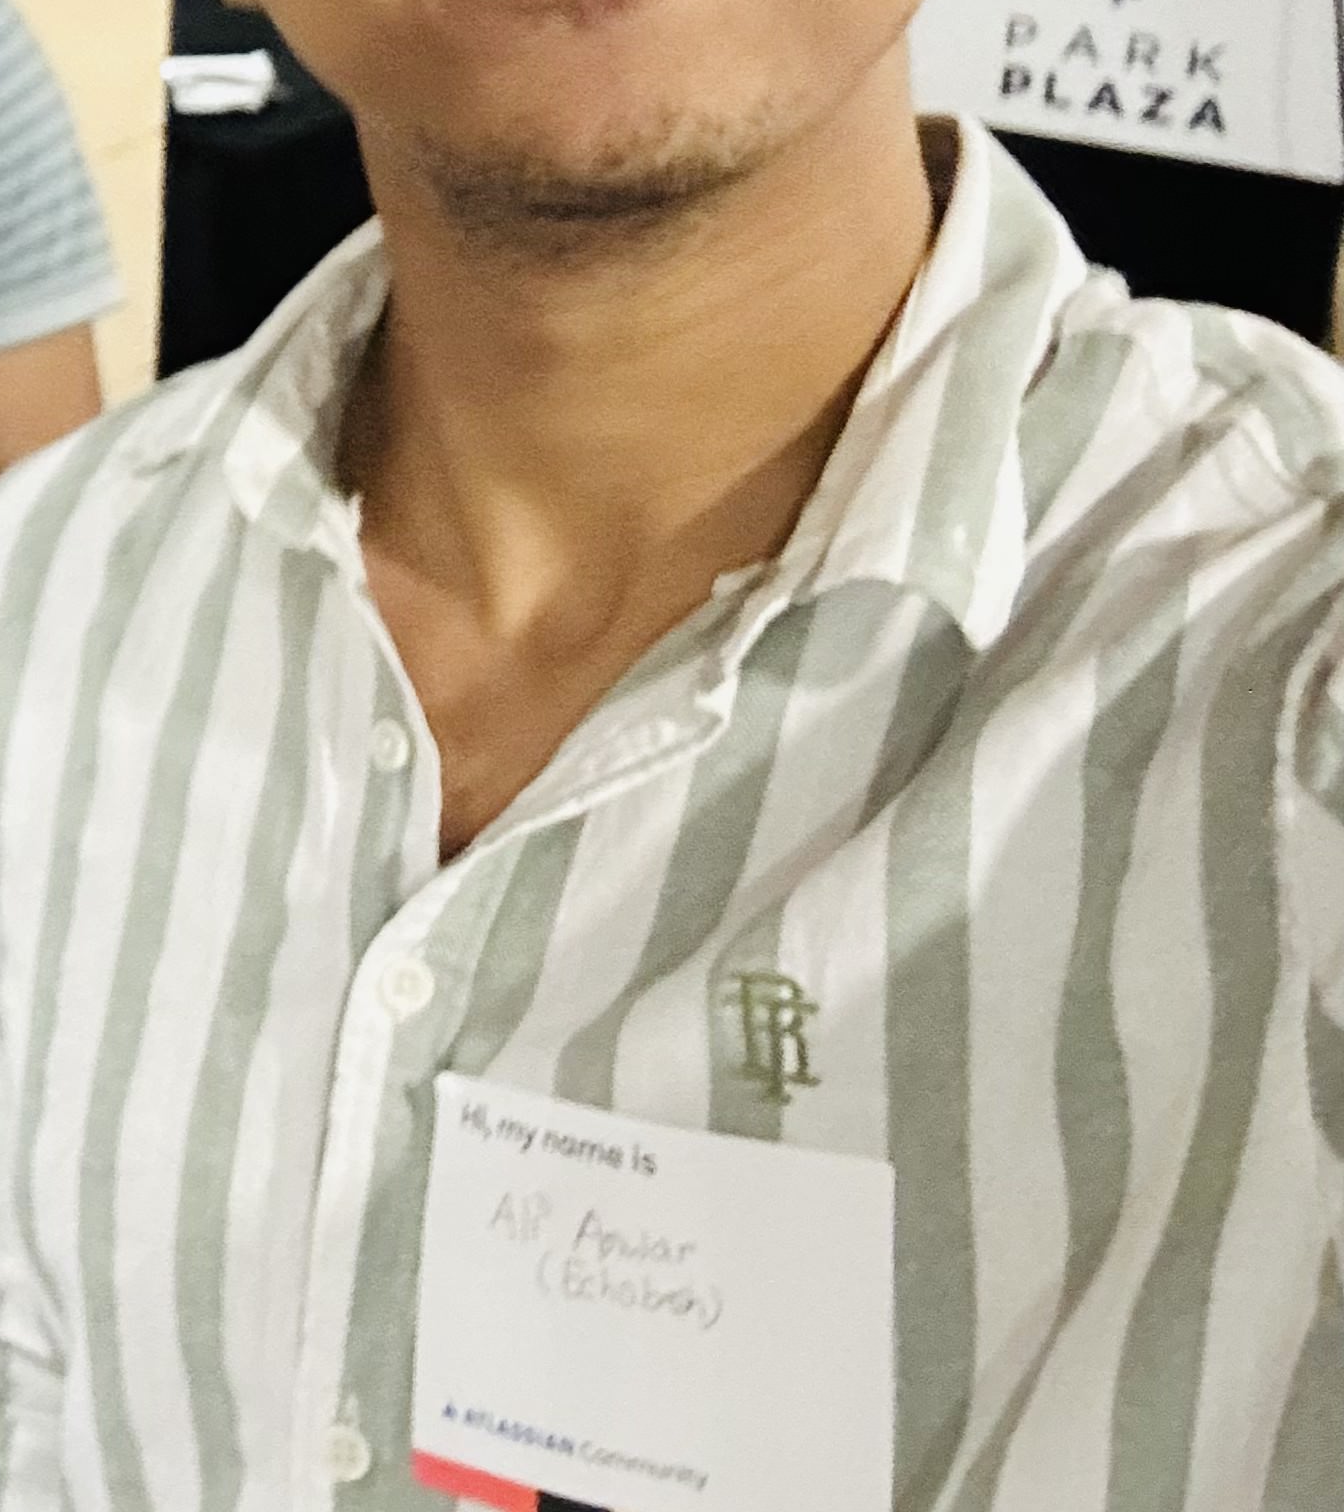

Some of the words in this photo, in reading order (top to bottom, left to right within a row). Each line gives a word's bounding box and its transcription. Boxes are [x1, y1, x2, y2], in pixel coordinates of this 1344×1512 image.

[1006, 12, 1224, 83] PARK
[999, 62, 1227, 136] PLAZA
[495, 1118, 538, 1155] my
[541, 1129, 624, 1170] name
[630, 1143, 657, 1177] is
[463, 1408, 575, 1456] ATLASSIAN
[578, 1438, 709, 1492] Community
